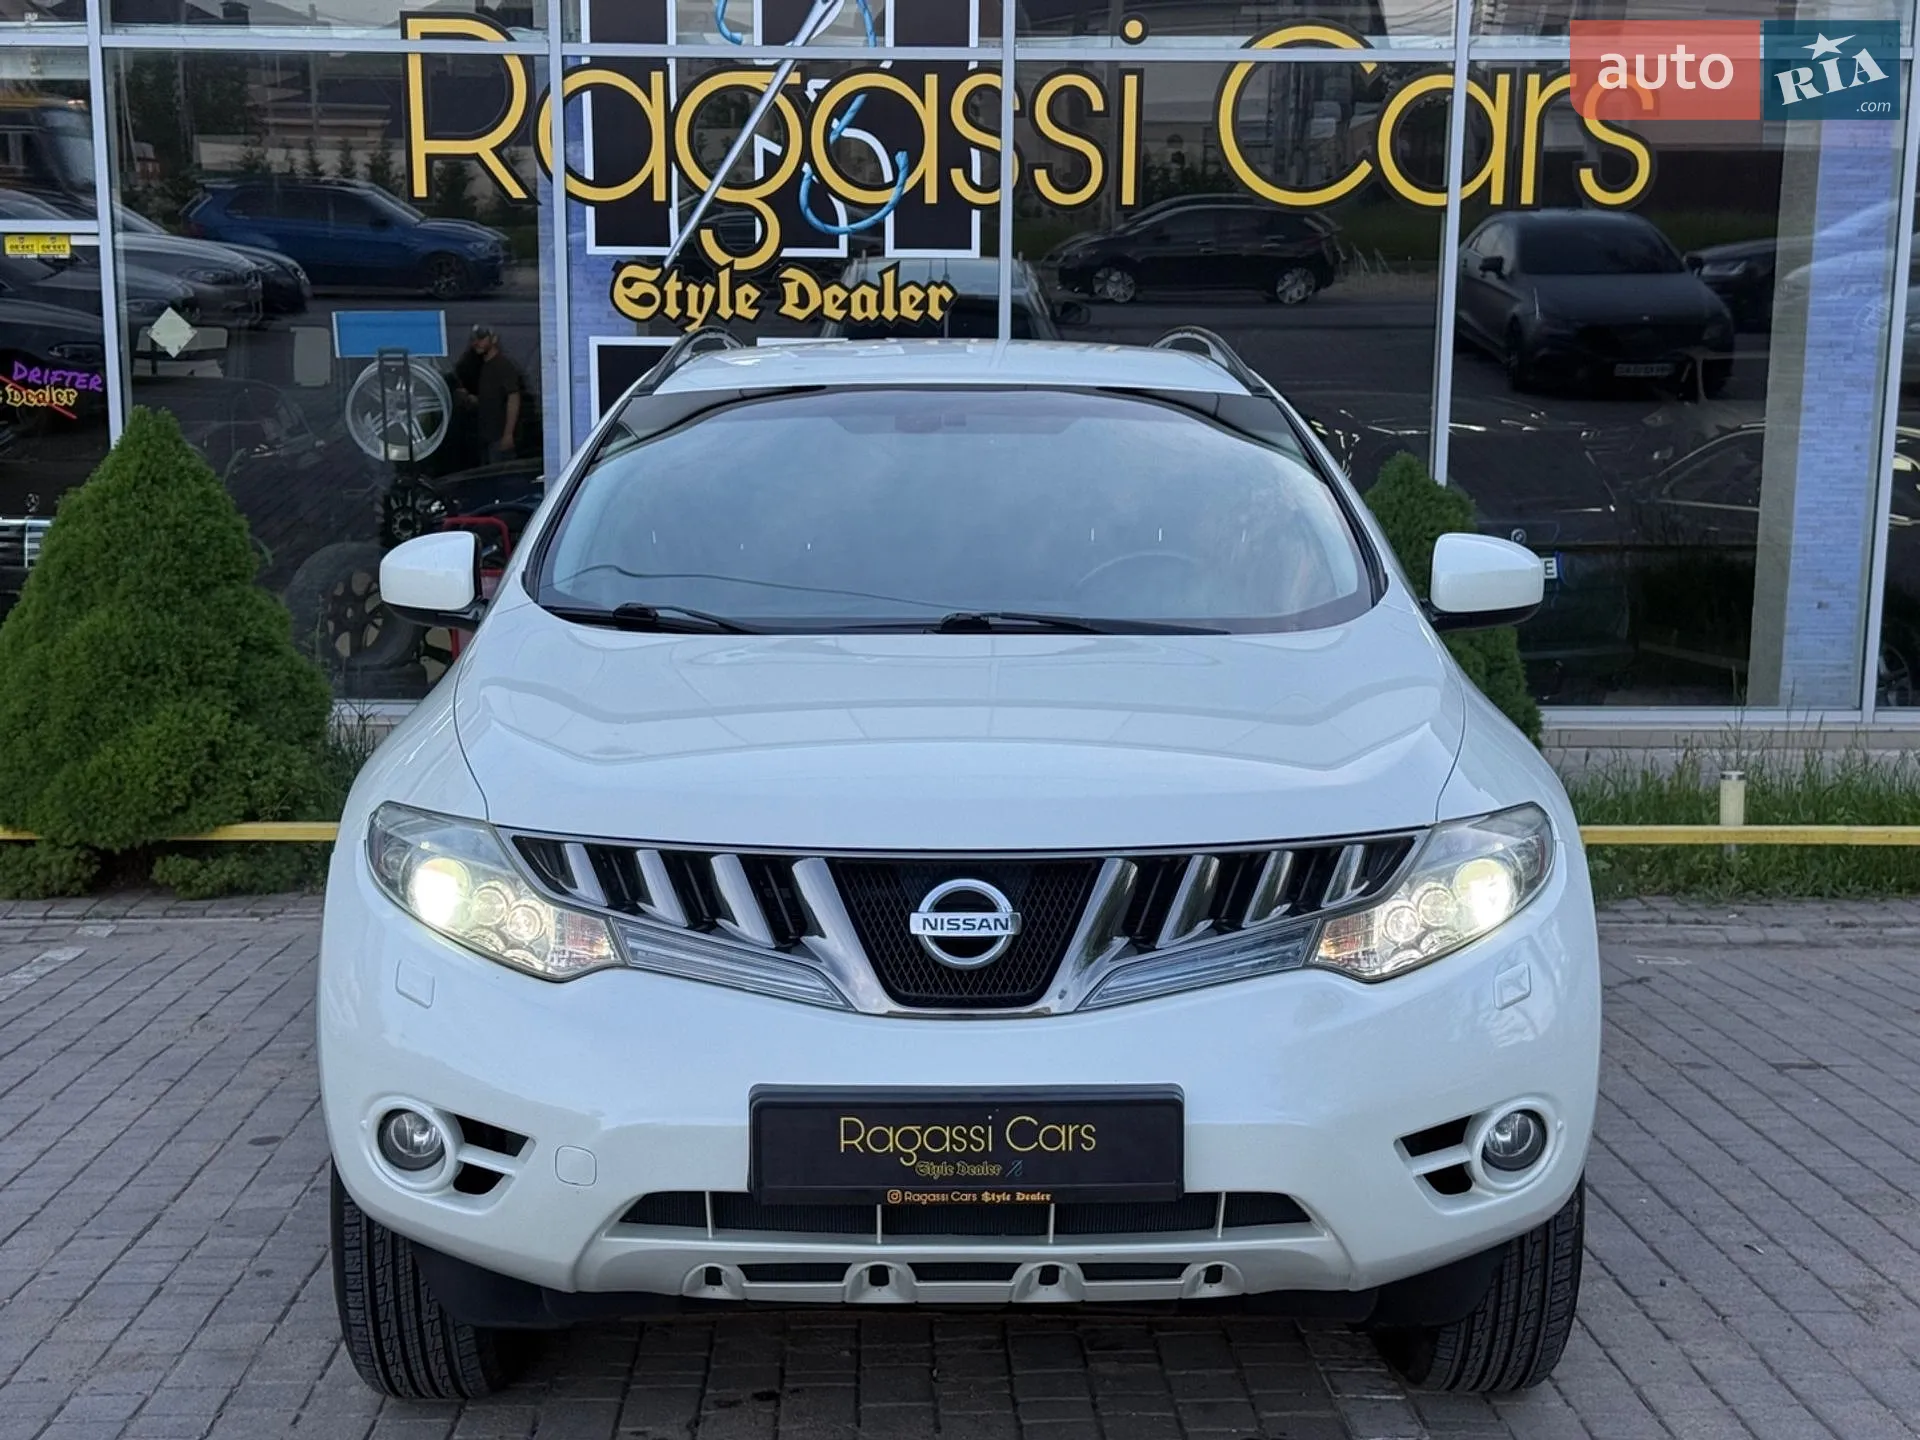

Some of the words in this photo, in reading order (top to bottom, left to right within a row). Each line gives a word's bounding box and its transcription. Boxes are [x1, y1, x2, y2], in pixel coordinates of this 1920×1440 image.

[406, 18, 1140, 270] Ragassi
[1218, 25, 1655, 206] Cars
[611, 261, 760, 332] Style
[779, 262, 956, 323] Dealer
[12, 360, 103, 392] DRIFTER
[5, 383, 79, 407] Dealer
[922, 917, 1009, 931] NISSAN
[839, 1116, 993, 1166] Ragassi
[1005, 1115, 1097, 1153] Cars
[915, 1160, 955, 1179] Style
[956, 1160, 1003, 1177] Dealer
[904, 1190, 949, 1205] Ragassi
[950, 1190, 978, 1202] Cars
[981, 1190, 1011, 1203] Style
[1016, 1191, 1052, 1203] Dealer
